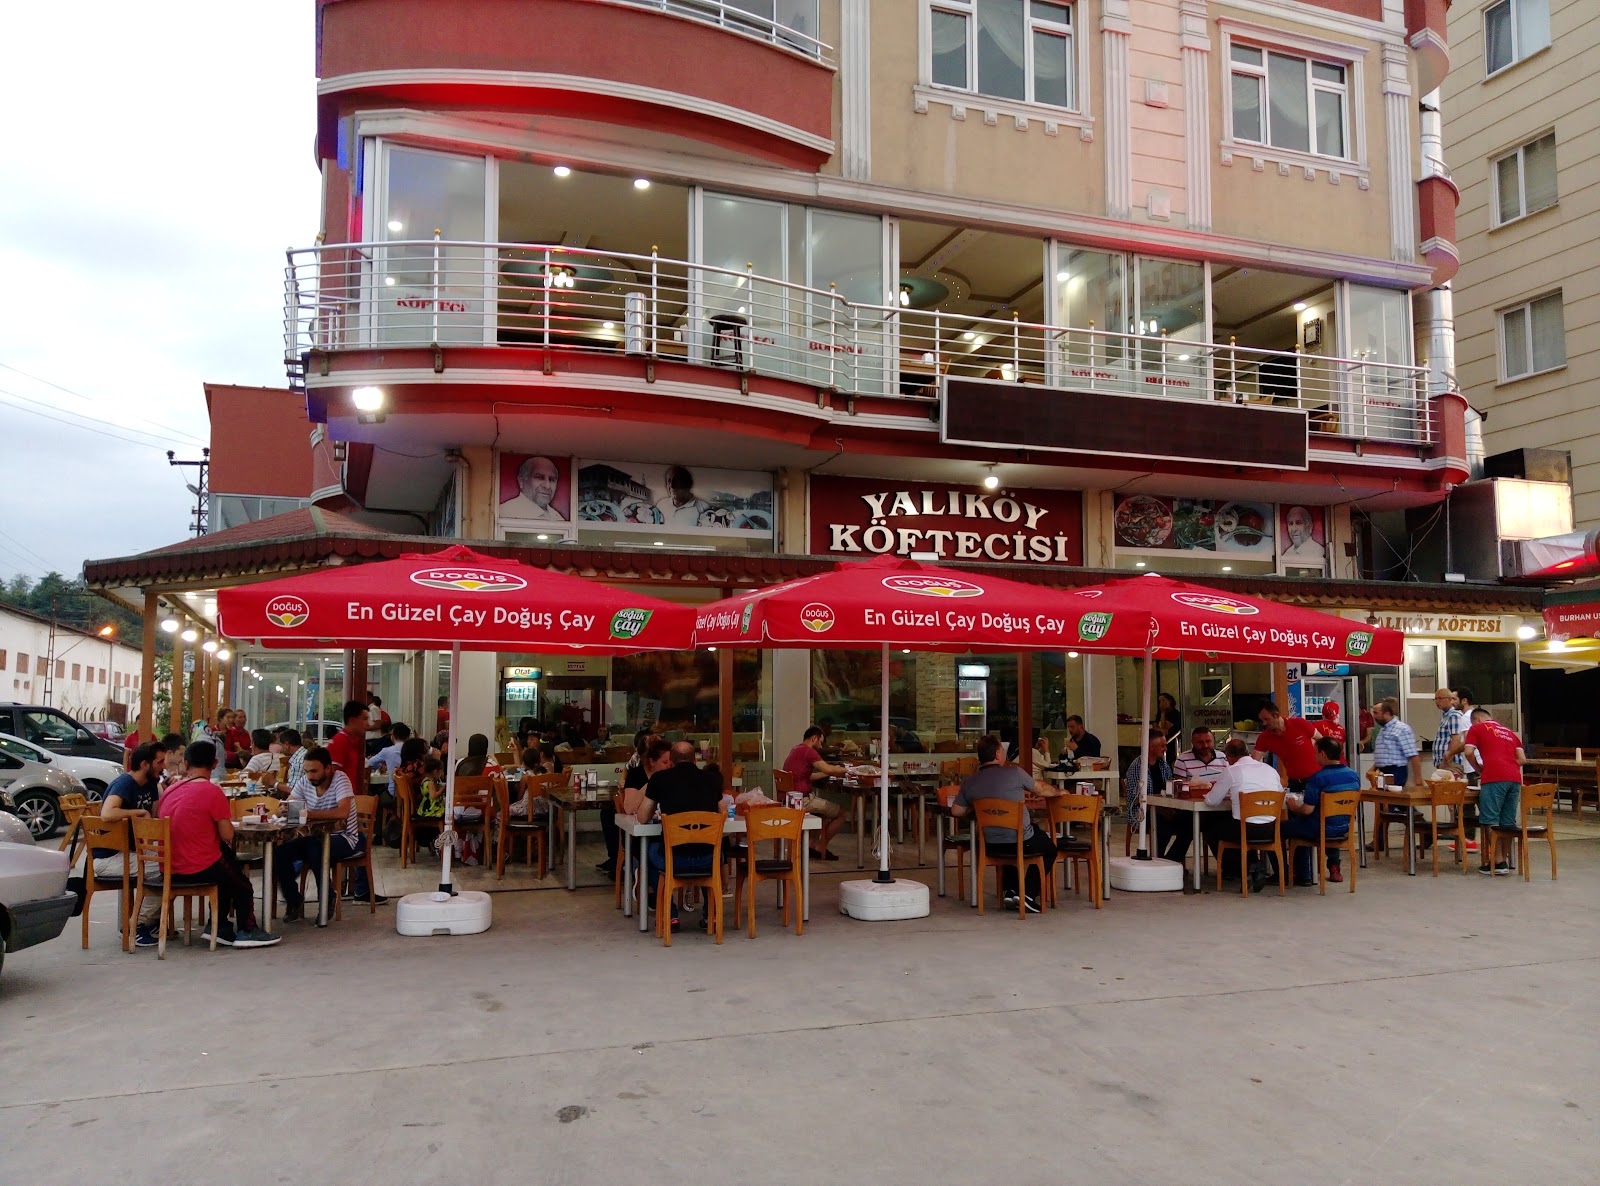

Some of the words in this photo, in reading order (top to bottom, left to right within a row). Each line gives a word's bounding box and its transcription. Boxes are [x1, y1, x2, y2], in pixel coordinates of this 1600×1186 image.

[861, 490, 1049, 531] YALIKÖY
[829, 519, 1069, 562] KÖFTECİSİ
[429, 571, 508, 583] DOĞUŞ
[272, 602, 303, 613] DOĞUŞ
[618, 610, 646, 621] soğuk
[805, 608, 830, 619] DOĞUŞ
[347, 602, 373, 620] En
[381, 602, 442, 622] Güzel
[449, 605, 487, 627] Çay
[493, 606, 553, 629] Doğuş
[559, 609, 595, 632] Çay
[864, 608, 886, 625] En
[891, 609, 941, 627] Güzel
[945, 611, 976, 631] Çay
[981, 612, 1031, 634] Doğuş
[1035, 615, 1065, 635] Çay
[1083, 614, 1107, 624] soğuk
[1364, 614, 1434, 631] ALIKÖY
[1437, 615, 1502, 632] KÖFTESİ
[1559, 613, 1592, 622] BURHAN
[614, 619, 642, 637] çay
[1082, 622, 1105, 638] çay
[1180, 621, 1199, 636] En
[1201, 622, 1240, 639] Güzel
[1242, 626, 1267, 644] Çay
[1269, 628, 1309, 648] Doğuş
[1311, 631, 1336, 650] Çay
[1349, 640, 1367, 654] çay
